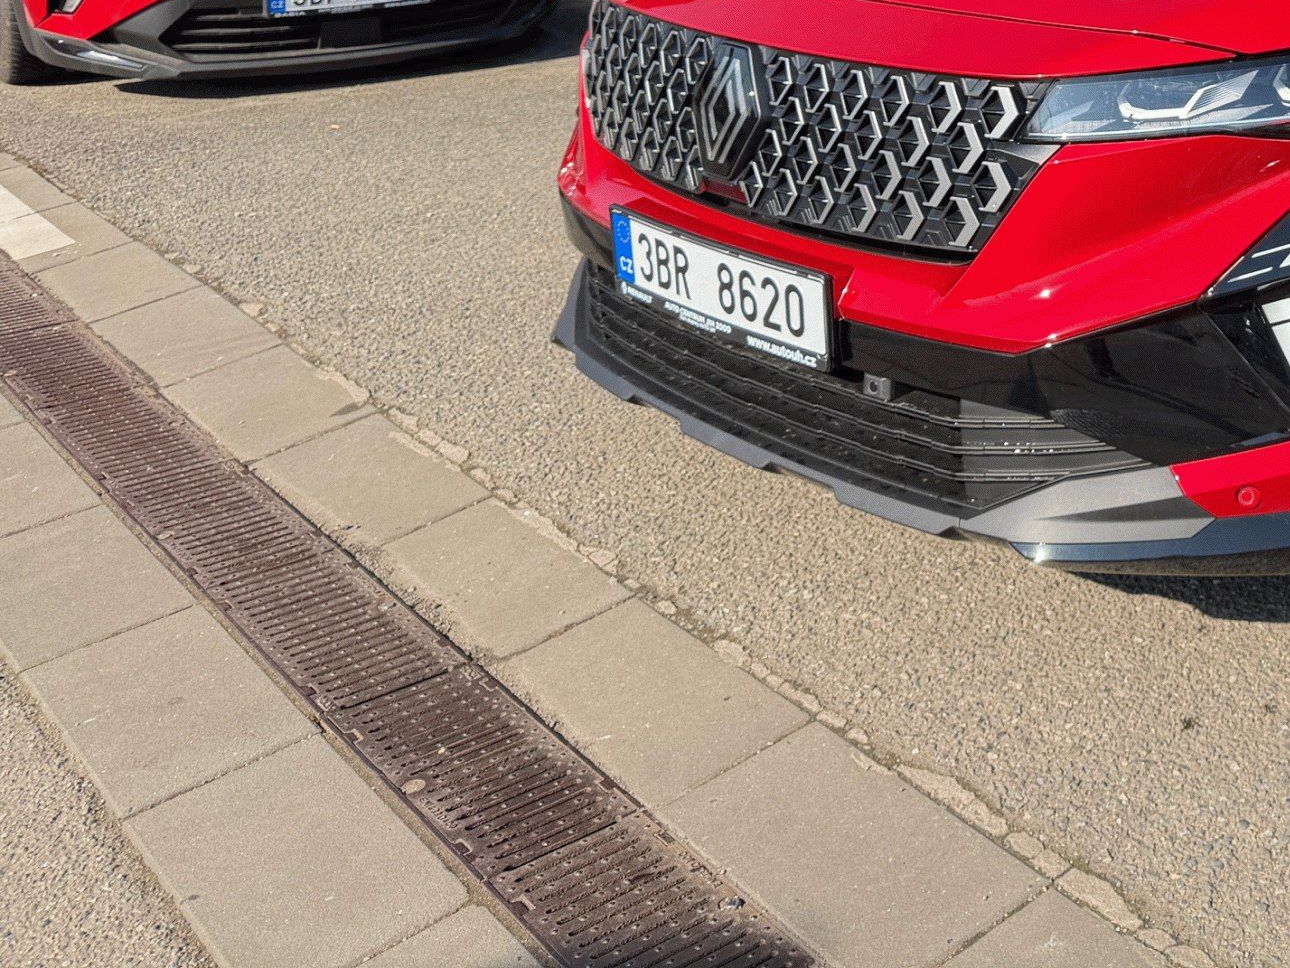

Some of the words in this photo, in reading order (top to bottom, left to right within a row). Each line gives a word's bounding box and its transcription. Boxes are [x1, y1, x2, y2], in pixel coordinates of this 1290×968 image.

[271, 0, 284, 9] CZ
[619, 256, 634, 274] CZ
[638, 233, 692, 300] 3BR
[717, 262, 805, 337] 8620
[746, 335, 817, 368] www.autouh.cz
